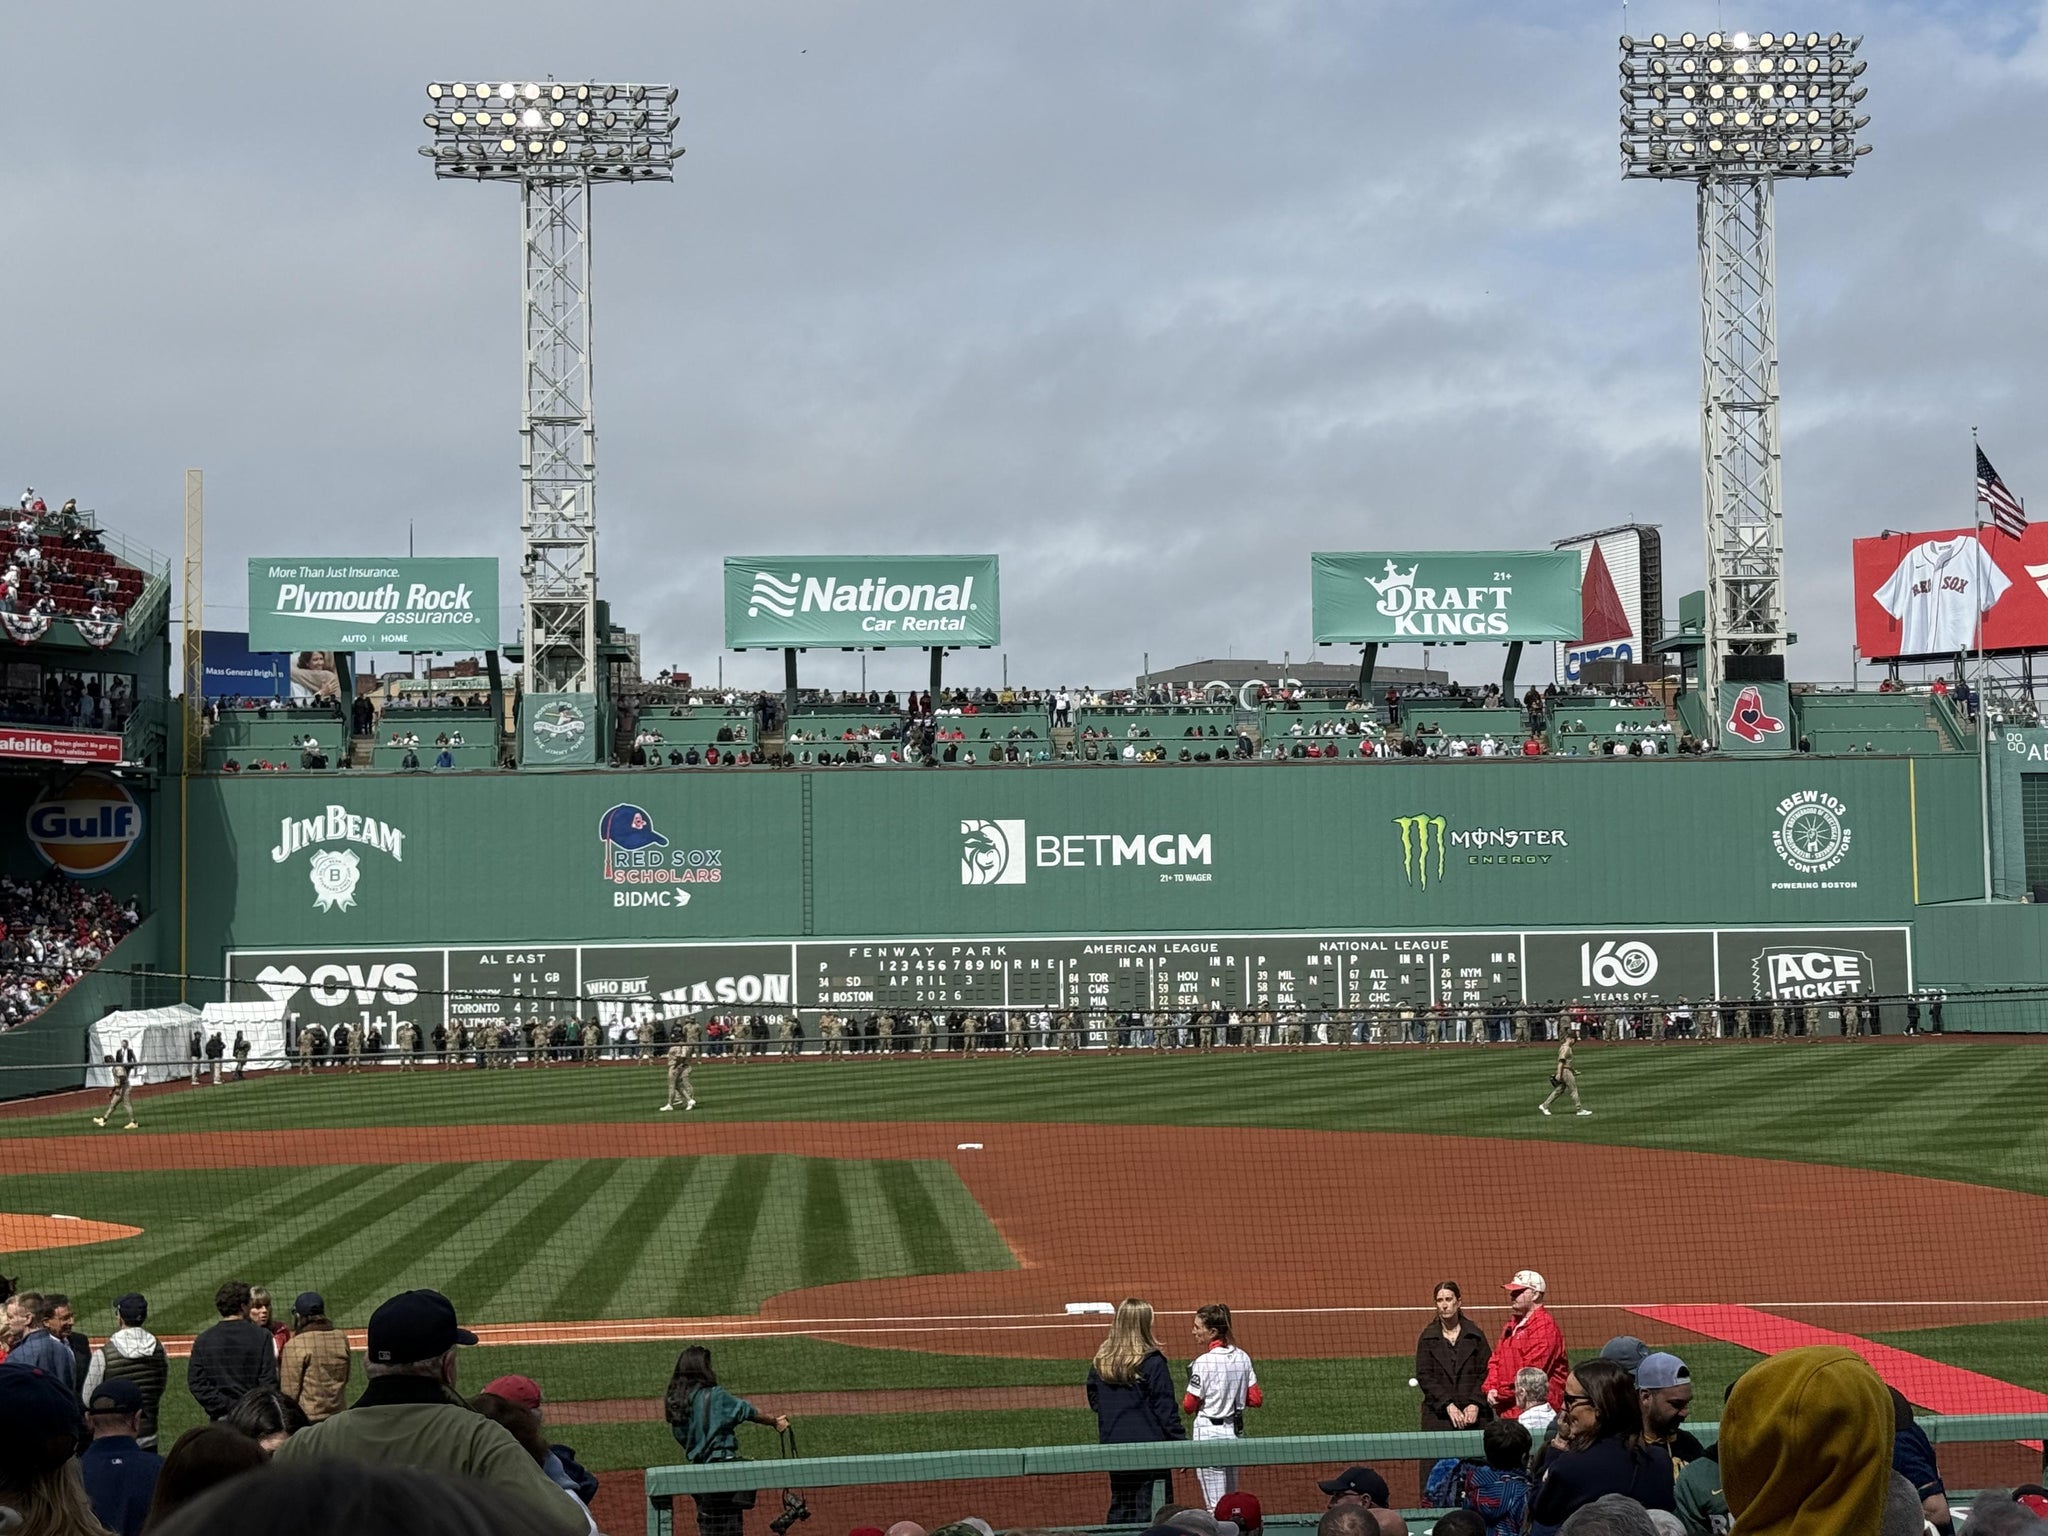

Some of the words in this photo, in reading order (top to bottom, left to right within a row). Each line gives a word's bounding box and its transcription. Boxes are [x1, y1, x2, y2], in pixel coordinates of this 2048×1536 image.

[269, 567, 297, 578] More
[299, 567, 324, 578] Than
[326, 566, 347, 578] Just
[349, 567, 400, 578] Insurance.
[1493, 572, 1512, 581] 21+
[1942, 576, 1968, 594] SOX
[277, 584, 400, 613] Plymouth
[406, 583, 473, 609] Rock
[801, 576, 973, 612] National
[1376, 585, 1512, 616] DRAFT
[385, 611, 473, 624] assurance
[1394, 611, 1510, 635] KINGS
[862, 617, 896, 632] Car
[902, 616, 966, 631] Rental
[206, 667, 224, 675] Mass
[226, 668, 253, 676] General
[254, 669, 284, 678] Brighm
[1776, 791, 1818, 816] IBEW
[1820, 793, 1846, 816] 103
[32, 806, 133, 838] Gulf
[272, 815, 326, 863] JIM
[326, 805, 402, 862] BEAM
[1450, 828, 1568, 849] MONSTER
[1036, 834, 1212, 867] BETMGM
[1772, 830, 1788, 860] NECA
[1788, 828, 1851, 873] CONTRACTORS
[614, 850, 664, 867] RED
[672, 850, 722, 866] SOX
[1468, 855, 1552, 865] ENERGY
[330, 869, 340, 881] B
[614, 868, 721, 884] SCHOLARS
[614, 891, 671, 907] BIDMC
[849, 947, 934, 957] FENWAY
[952, 946, 1006, 956] PARK
[1083, 944, 1156, 953] AMERICAN
[1164, 944, 1218, 953] LEAGUE
[1320, 942, 1387, 951] NATIONAL
[1395, 941, 1448, 950] LEAGUE
[480, 954, 498, 964] AL
[506, 954, 546, 963] EAST
[1070, 959, 1077, 968] P
[1119, 958, 1130, 967] IN
[1136, 958, 1143, 967] R
[1159, 957, 1166, 967] P
[1210, 956, 1220, 966] IN
[1227, 956, 1235, 966] R
[1258, 956, 1265, 966] P
[1307, 956, 1318, 965] IN
[1324, 956, 1332, 965] R
[1351, 955, 1358, 964] P
[1400, 954, 1410, 963] IN
[1416, 954, 1424, 963] R
[1443, 954, 1450, 963] P
[1492, 953, 1502, 962] IN
[1508, 953, 1516, 962] R
[1581, 941, 1658, 986] 160
[820, 962, 828, 972] P
[880, 961, 884, 970] 1
[890, 961, 897, 971] 2
[901, 961, 908, 971] 3
[916, 961, 924, 970] 4
[928, 961, 935, 970] 5
[938, 960, 946, 971] 6
[954, 960, 960, 970] 7
[965, 960, 973, 970] 8
[976, 960, 984, 970] 9
[991, 960, 1002, 970] 10
[1014, 959, 1022, 969] R
[1031, 959, 1039, 968] H
[1048, 959, 1054, 968] E
[1777, 952, 1860, 985] ACE
[513, 973, 521, 983] W
[531, 973, 538, 983] L
[545, 973, 560, 982] GB
[819, 977, 829, 987] 34
[846, 977, 861, 986] SD
[890, 976, 946, 986] APRIL
[966, 976, 972, 984] 3
[1069, 973, 1079, 983] 84
[1088, 973, 1109, 982] TOR
[1159, 972, 1168, 981] 53
[1177, 972, 1198, 981] HOU
[1212, 978, 1220, 987] N
[1258, 971, 1268, 980] 39
[1278, 971, 1295, 980] MIL
[1310, 976, 1317, 985] N
[1350, 970, 1359, 979] 67
[1370, 970, 1388, 978] ATL
[1401, 975, 1409, 984] N
[1441, 969, 1451, 978] 26
[1460, 968, 1481, 977] NYM
[1493, 974, 1500, 983] N
[310, 963, 418, 1006] CVS
[586, 982, 618, 995] WHO
[621, 980, 648, 993] BUT
[1069, 985, 1078, 994] 31
[1088, 985, 1109, 994] CWS
[1159, 984, 1168, 993] 59
[1179, 983, 1197, 992] ATH
[1258, 982, 1268, 991] 58
[1280, 983, 1294, 991] KC
[1349, 982, 1359, 990] 57
[1373, 981, 1386, 990] AZ
[1442, 980, 1452, 989] 54
[1464, 980, 1478, 989] SF
[1779, 980, 1861, 1000] TICKET
[819, 993, 829, 1002] 54
[833, 992, 873, 1002] BOSTON
[917, 991, 961, 1000] 2026
[1069, 997, 1079, 1006] 39
[1090, 997, 1107, 1006] MIA
[1159, 996, 1168, 1005] 22
[1178, 996, 1199, 1004] SEA
[1278, 994, 1296, 1003] BAL
[1350, 993, 1360, 1002] 22
[1369, 993, 1390, 1002] CHC
[1442, 992, 1452, 1000] 27
[1464, 992, 1480, 1000] PHI
[451, 1003, 500, 1013] TORONTO
[514, 1002, 521, 1012] 4
[531, 1002, 538, 1012] 2
[550, 1002, 554, 1012] 1
